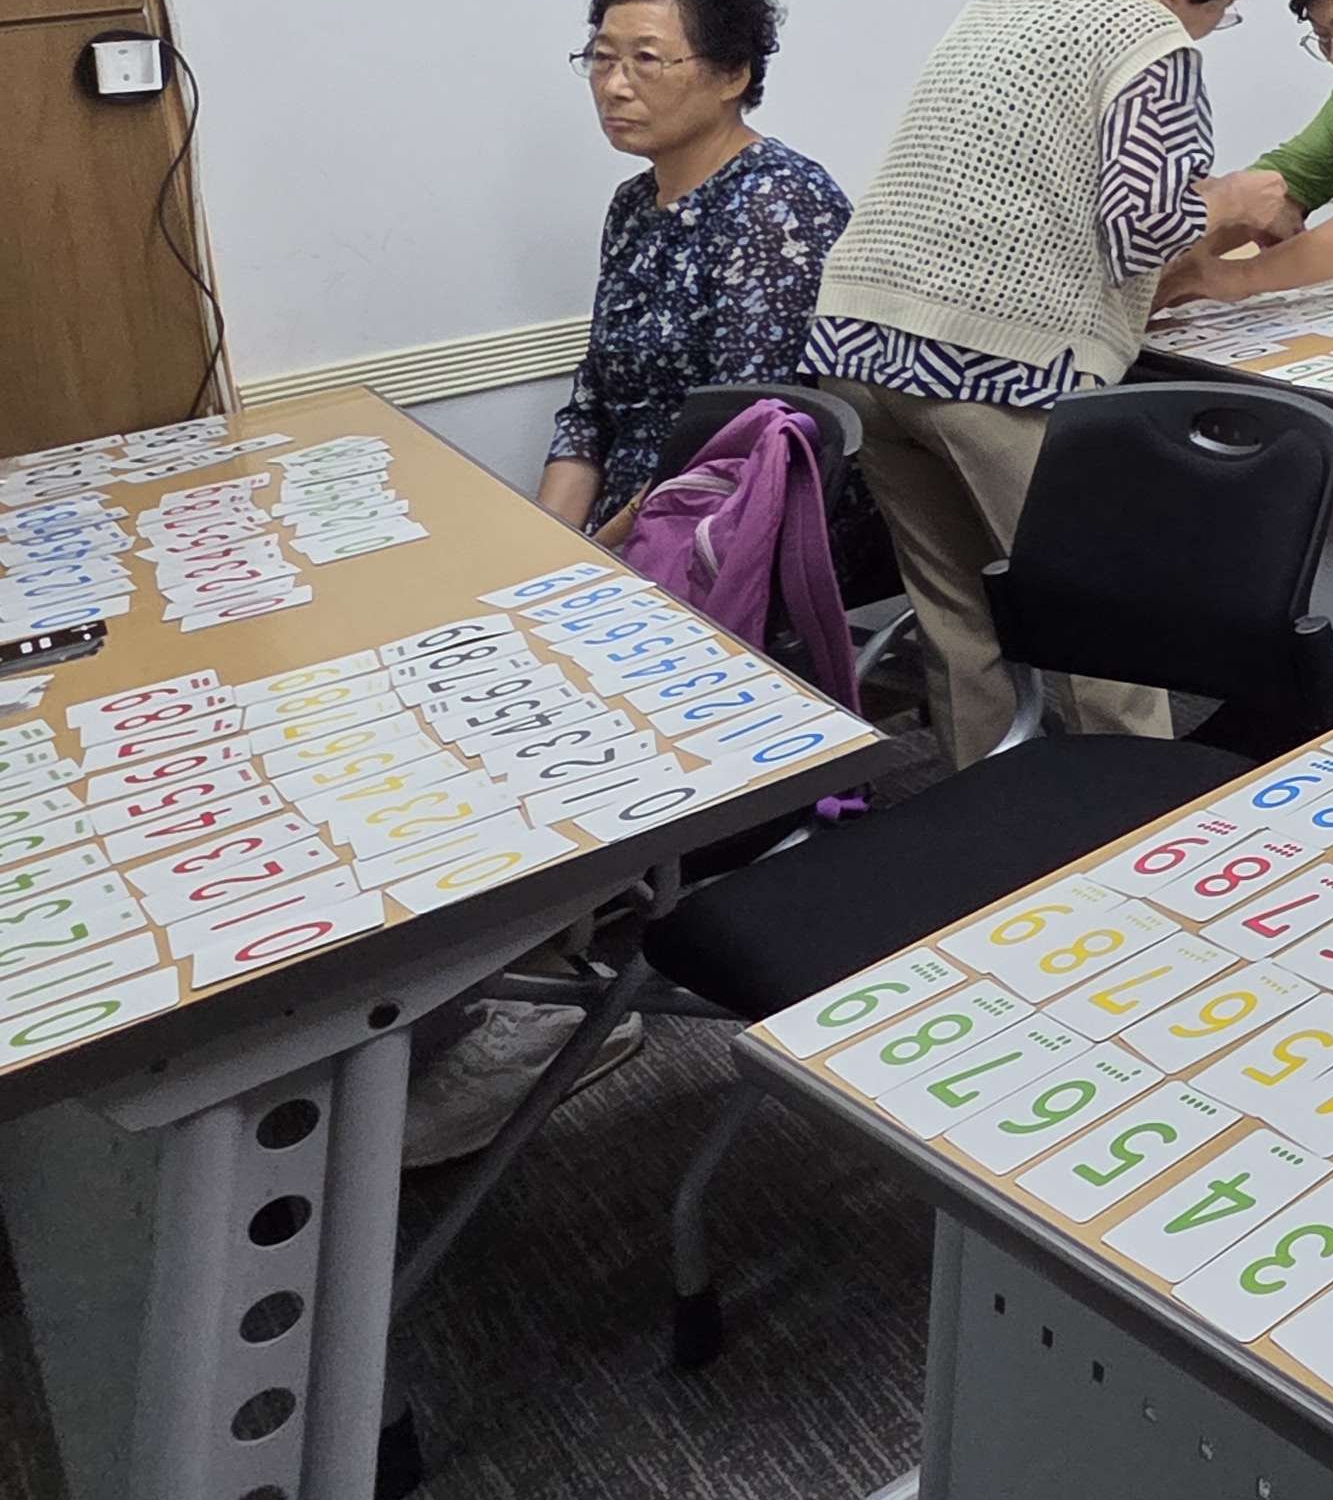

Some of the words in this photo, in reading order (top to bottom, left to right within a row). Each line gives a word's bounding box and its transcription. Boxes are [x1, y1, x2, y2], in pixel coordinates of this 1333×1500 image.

[561, 588, 622, 609] 8
[561, 608, 624, 631] 7
[429, 646, 498, 669] 8
[607, 637, 674, 662] 5
[427, 668, 498, 693] 7
[621, 657, 686, 678] 4
[659, 672, 727, 697] 3
[114, 704, 193, 730] 8
[466, 700, 540, 727] 5
[684, 691, 755, 719] 2
[491, 711, 563, 736] 4
[118, 730, 198, 758] 7
[516, 730, 591, 758] 3
[752, 734, 824, 763] 0
[539, 748, 615, 779] 2
[127, 784, 215, 817] 5
[618, 788, 696, 820] 0
[145, 808, 232, 838] 4
[172, 838, 262, 874] 3
[436, 852, 522, 889] 0
[189, 861, 284, 901] 2
[1195, 857, 1271, 897] 8
[1242, 895, 1319, 938] 7
[235, 921, 333, 961] 0
[1040, 930, 1124, 973] 8
[1089, 967, 1171, 1014] 7
[9, 1001, 121, 1047] 0
[880, 1015, 972, 1065] 8
[1243, 1030, 1333, 1086] 5
[927, 1052, 1022, 1107] 7
[1073, 1123, 1177, 1186] 5
[1164, 1173, 1256, 1233] 4
